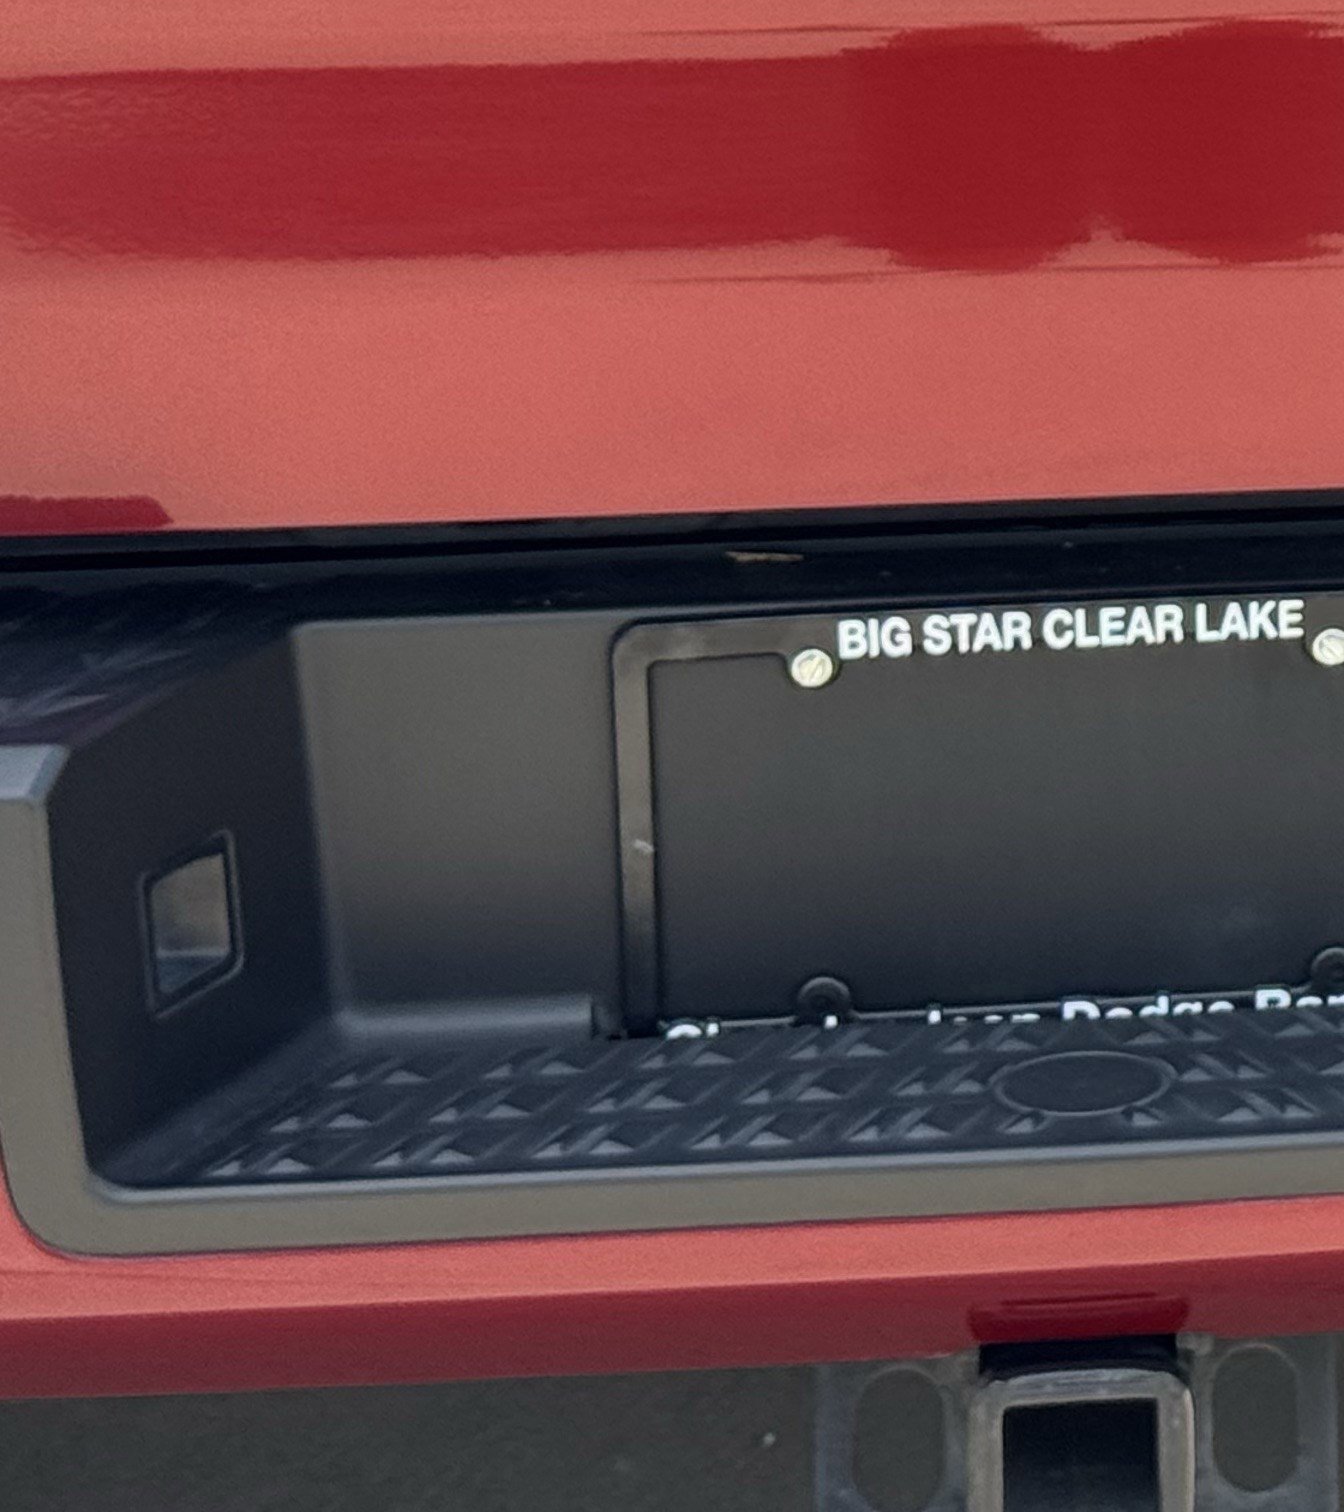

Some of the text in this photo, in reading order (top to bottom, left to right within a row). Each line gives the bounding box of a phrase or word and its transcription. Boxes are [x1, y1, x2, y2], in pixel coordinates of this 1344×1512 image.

[837, 599, 1305, 660] BIG STAR CLEAR LAKE
